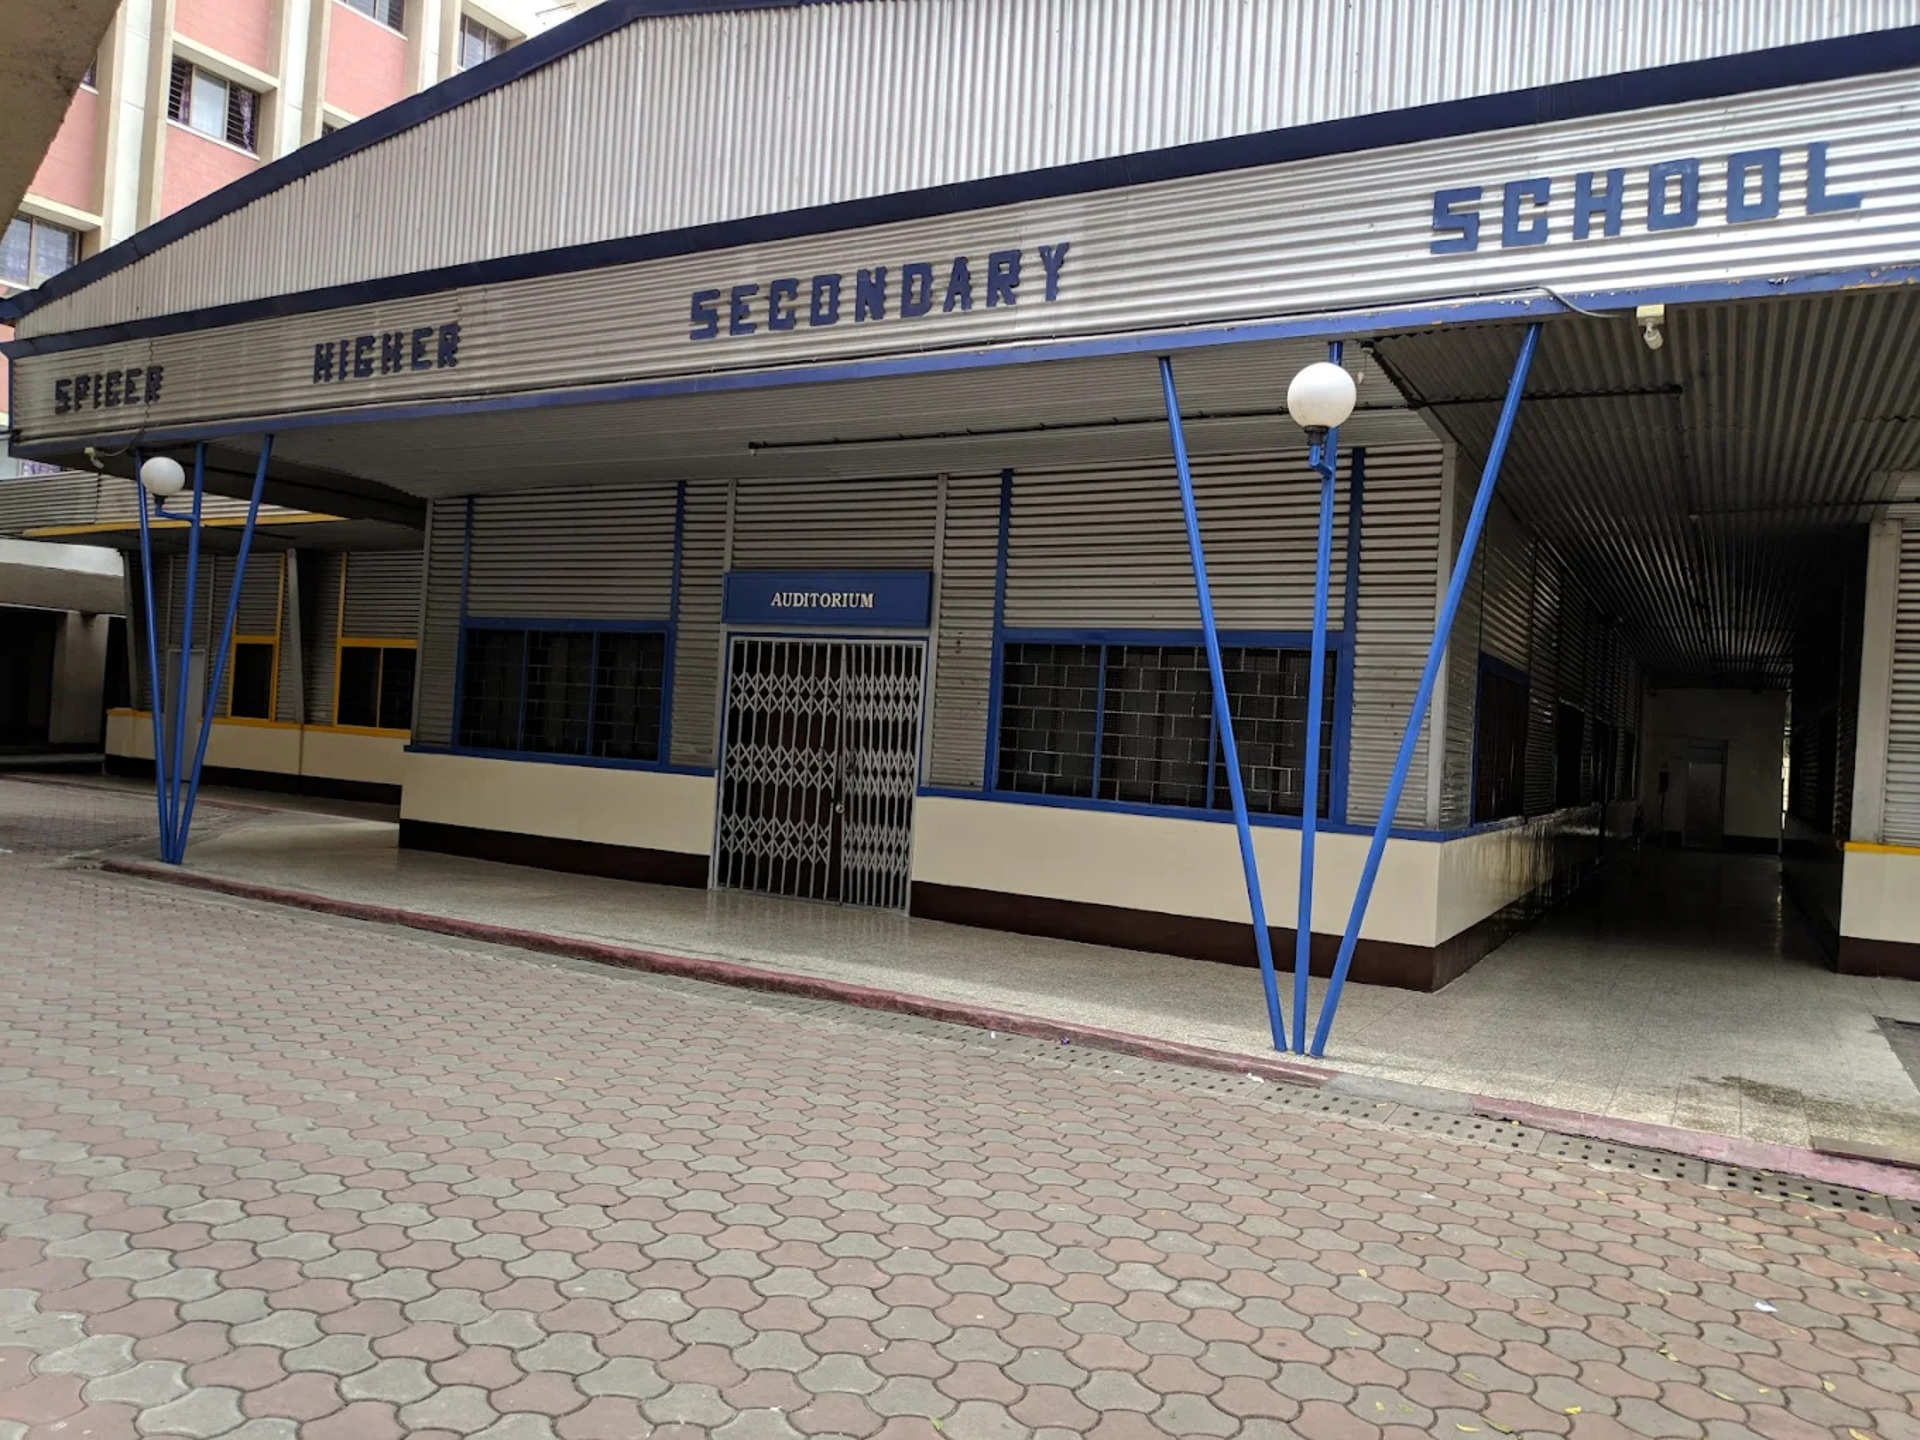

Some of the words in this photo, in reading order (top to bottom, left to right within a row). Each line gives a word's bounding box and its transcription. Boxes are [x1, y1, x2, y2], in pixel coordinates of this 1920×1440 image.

[55, 365, 164, 415] SPICER
[313, 323, 463, 384] HIGHER
[689, 242, 1070, 340] SECONDARY
[1430, 141, 1864, 255] SCHOOL
[770, 592, 874, 608] AUDITORIUM
